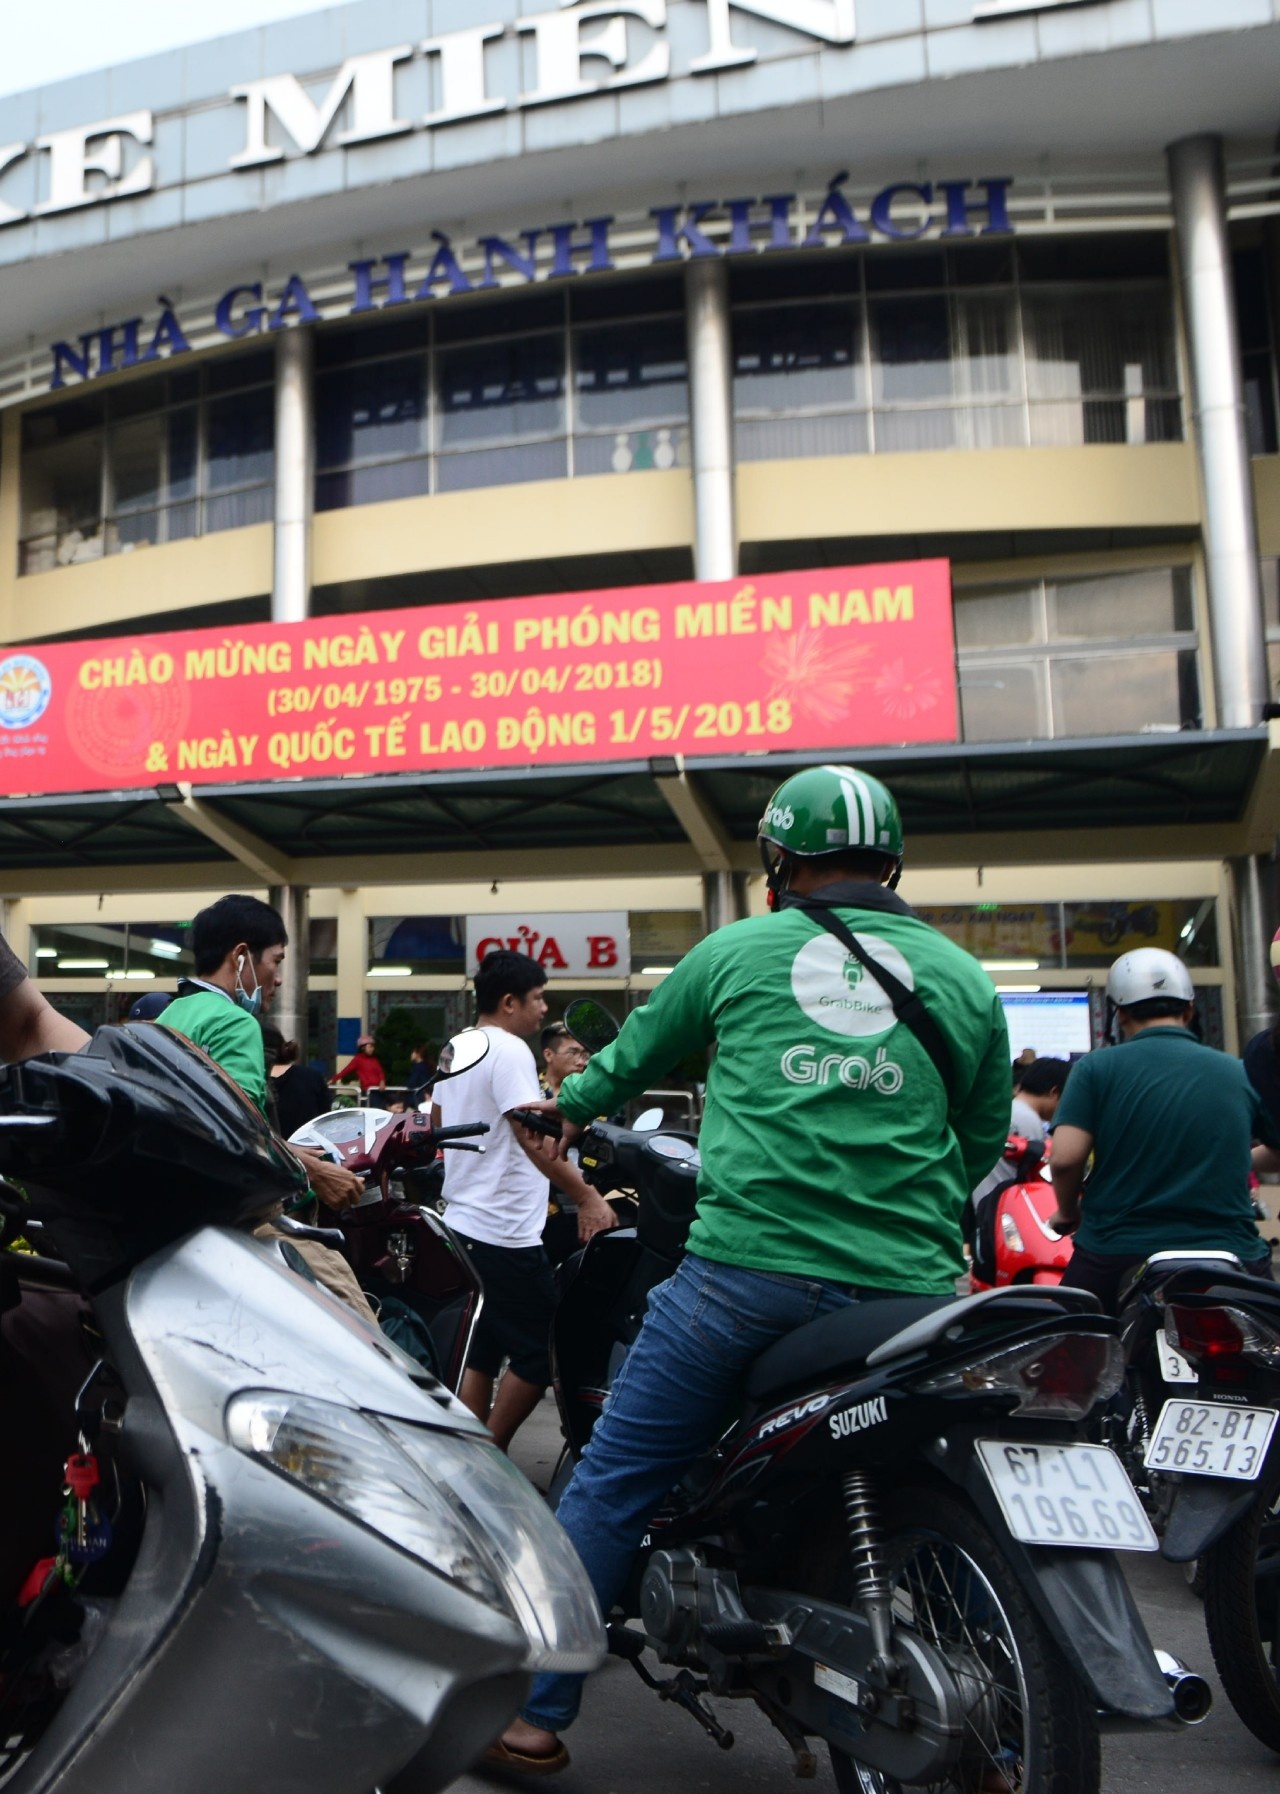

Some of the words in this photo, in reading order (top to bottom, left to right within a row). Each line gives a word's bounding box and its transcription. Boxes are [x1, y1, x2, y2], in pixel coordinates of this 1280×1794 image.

[50, 295, 192, 390] NHÀ
[214, 273, 323, 339] GA
[348, 214, 616, 314] HÀNH
[650, 171, 1016, 263] KHÁCH
[78, 647, 175, 690] CHÀO
[184, 639, 292, 682] MỪNG
[303, 625, 407, 670] NGÀY
[417, 610, 500, 660] GIẢI
[513, 603, 661, 652] PHÓNG
[674, 584, 793, 640] MIỀN
[808, 584, 915, 629] NAM
[267, 675, 443, 718] (30/04/1975
[470, 658, 664, 699] 30/04/2018)
[145, 741, 170, 772] &
[177, 729, 260, 771] NGÀY
[267, 716, 356, 769] QUỐC
[363, 711, 412, 758] TẾ
[419, 718, 488, 755] LAO
[495, 706, 597, 755] ĐỘNG
[608, 696, 794, 744] 1/5/2018
[475, 924, 569, 970] CỬA
[585, 935, 619, 969] B
[819, 995, 883, 1015] GrabBike
[780, 1044, 904, 1096] Grab
[758, 1394, 831, 1439] REVO
[828, 1396, 889, 1440] SUZUKI
[1212, 1393, 1249, 1402] HONDA
[1175, 1406, 1257, 1441] 82-B1
[1003, 1446, 1109, 1493] 67-L1
[1153, 1436, 1259, 1475] 565.13
[1010, 1493, 1146, 1541] 196.69
